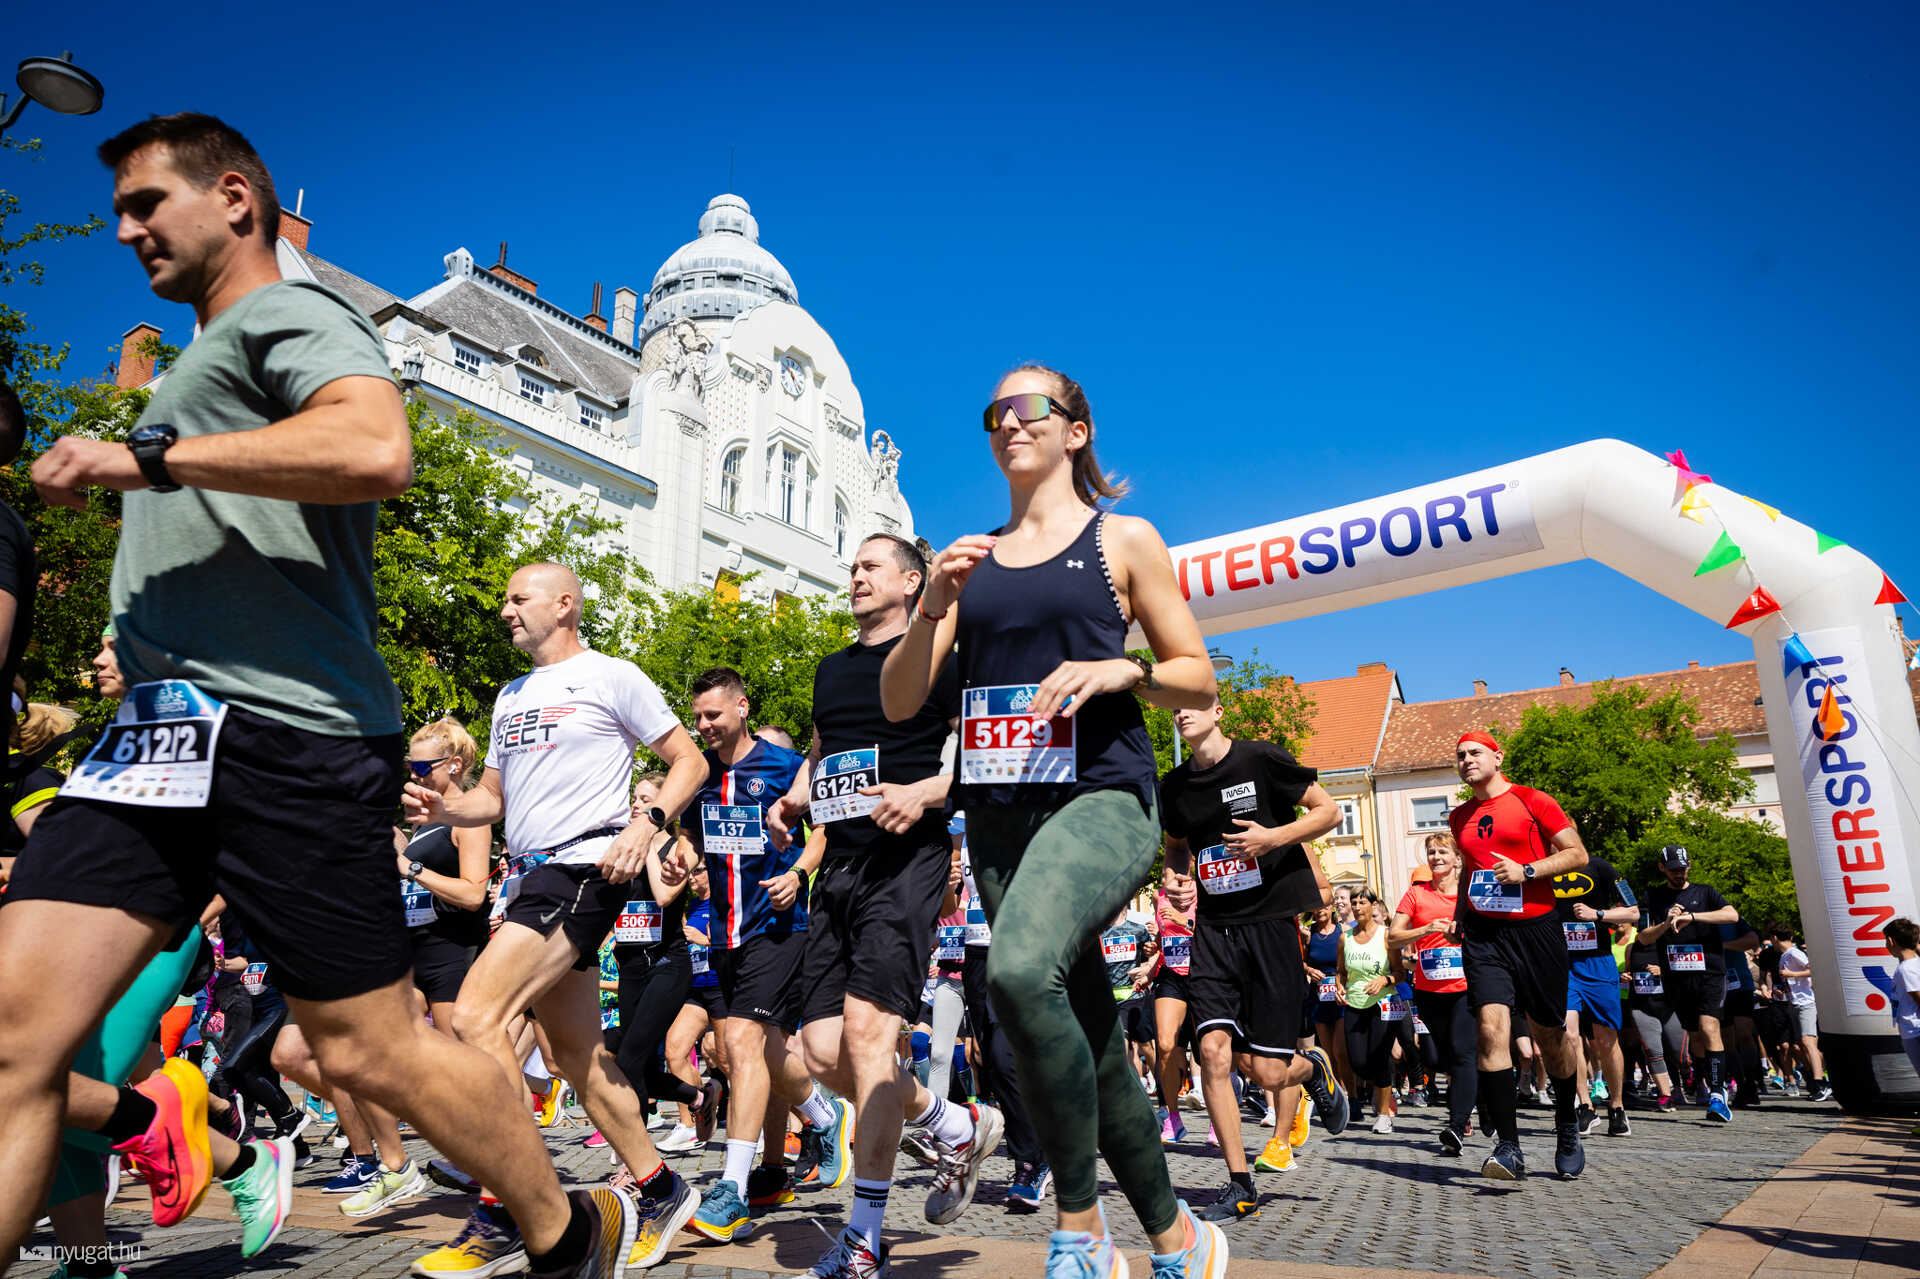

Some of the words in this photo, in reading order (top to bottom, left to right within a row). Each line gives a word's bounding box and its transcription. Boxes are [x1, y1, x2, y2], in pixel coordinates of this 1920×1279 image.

[975, 719, 1053, 748] 5129
[112, 725, 198, 763] 612/2
[816, 772, 869, 800] 612/3
[1226, 785, 1250, 799] NASA
[1801, 655, 1896, 957] INTERSPORT
[718, 822, 746, 837] 137
[1207, 859, 1247, 878] 5126
[1484, 884, 1503, 896] 24
[622, 915, 654, 928] 5067
[946, 937, 959, 947] 93
[1109, 945, 1130, 954] 5057
[1171, 946, 1191, 956] 124
[1435, 958, 1452, 969] 25
